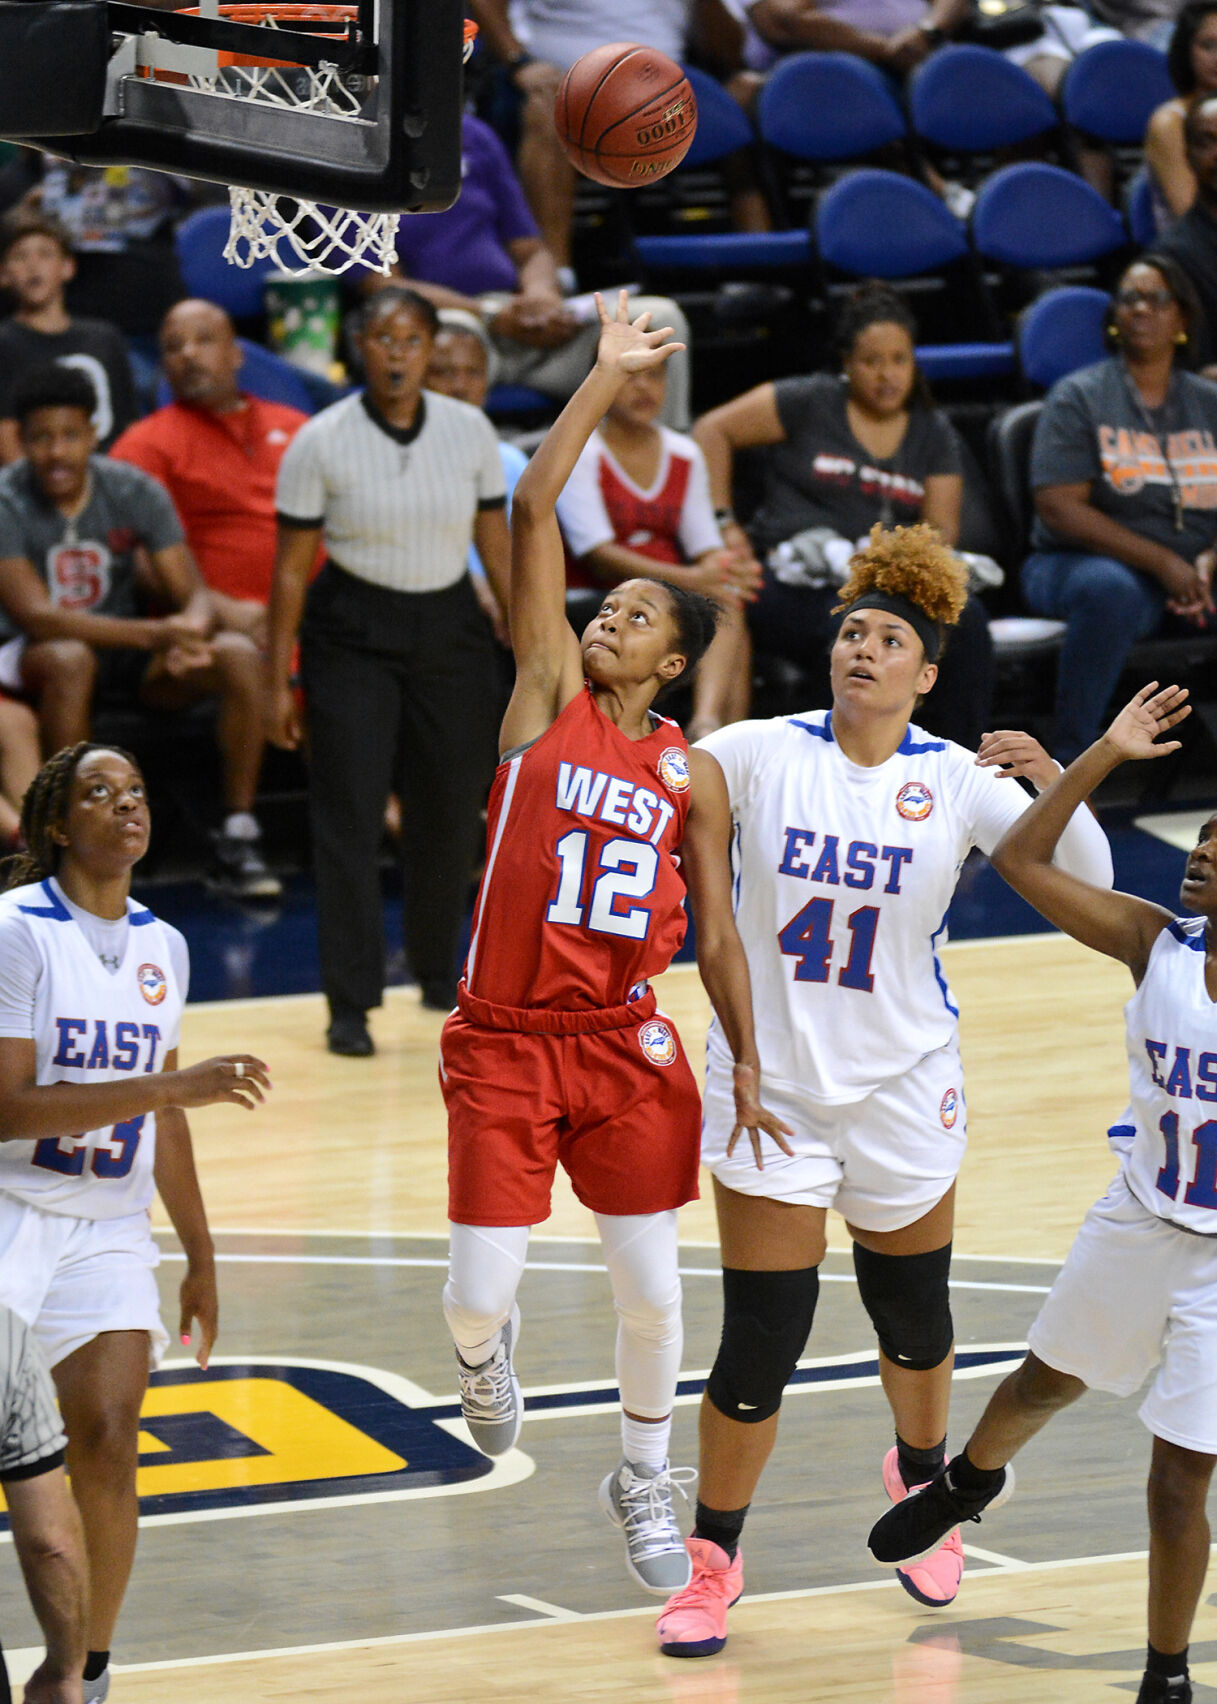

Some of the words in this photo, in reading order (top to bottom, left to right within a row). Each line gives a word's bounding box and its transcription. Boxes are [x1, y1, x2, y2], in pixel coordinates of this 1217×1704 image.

[556, 761, 675, 846] WEST
[545, 828, 660, 941] 12
[778, 826, 914, 895] EAST
[777, 896, 881, 993] 41
[52, 1017, 162, 1073] EAST
